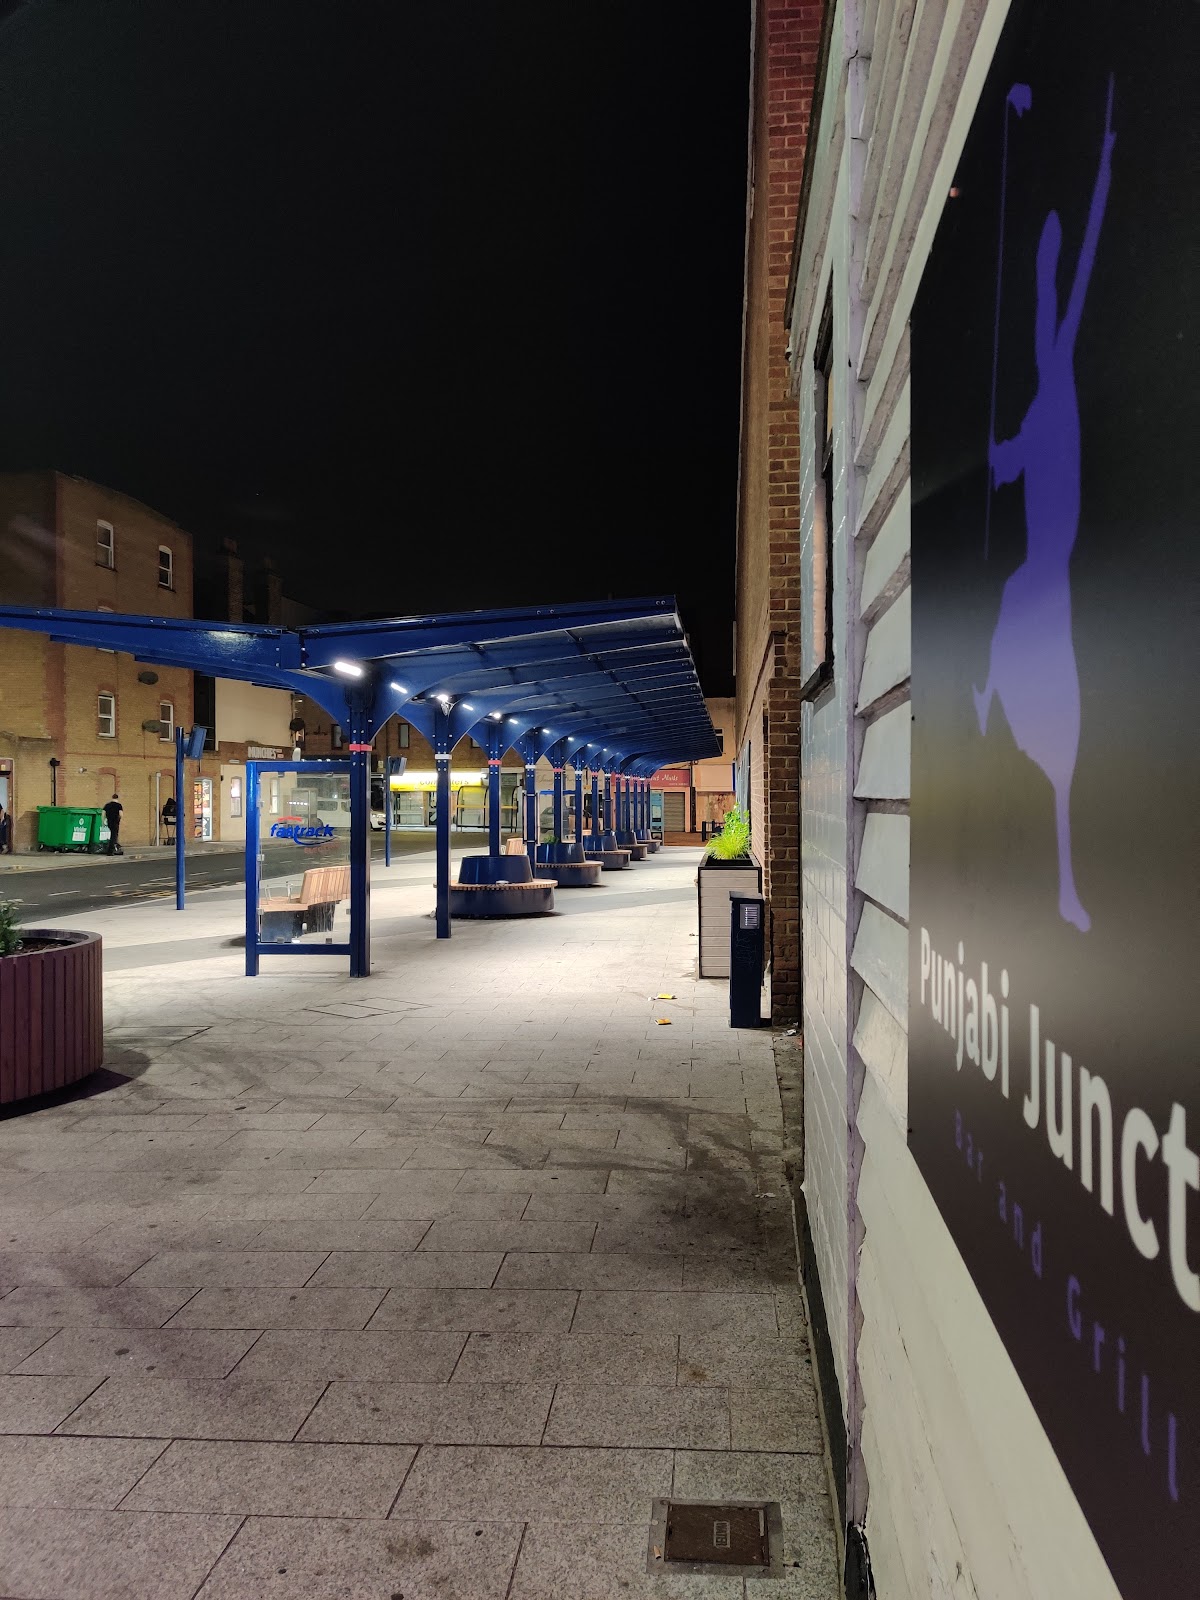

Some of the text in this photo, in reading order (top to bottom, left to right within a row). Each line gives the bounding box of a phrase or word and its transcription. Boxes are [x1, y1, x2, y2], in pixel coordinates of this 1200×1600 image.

[270, 823, 335, 840] fastrack
[920, 926, 1010, 1099] Punjabi
[954, 1108, 1179, 1502] Bar and Grill
